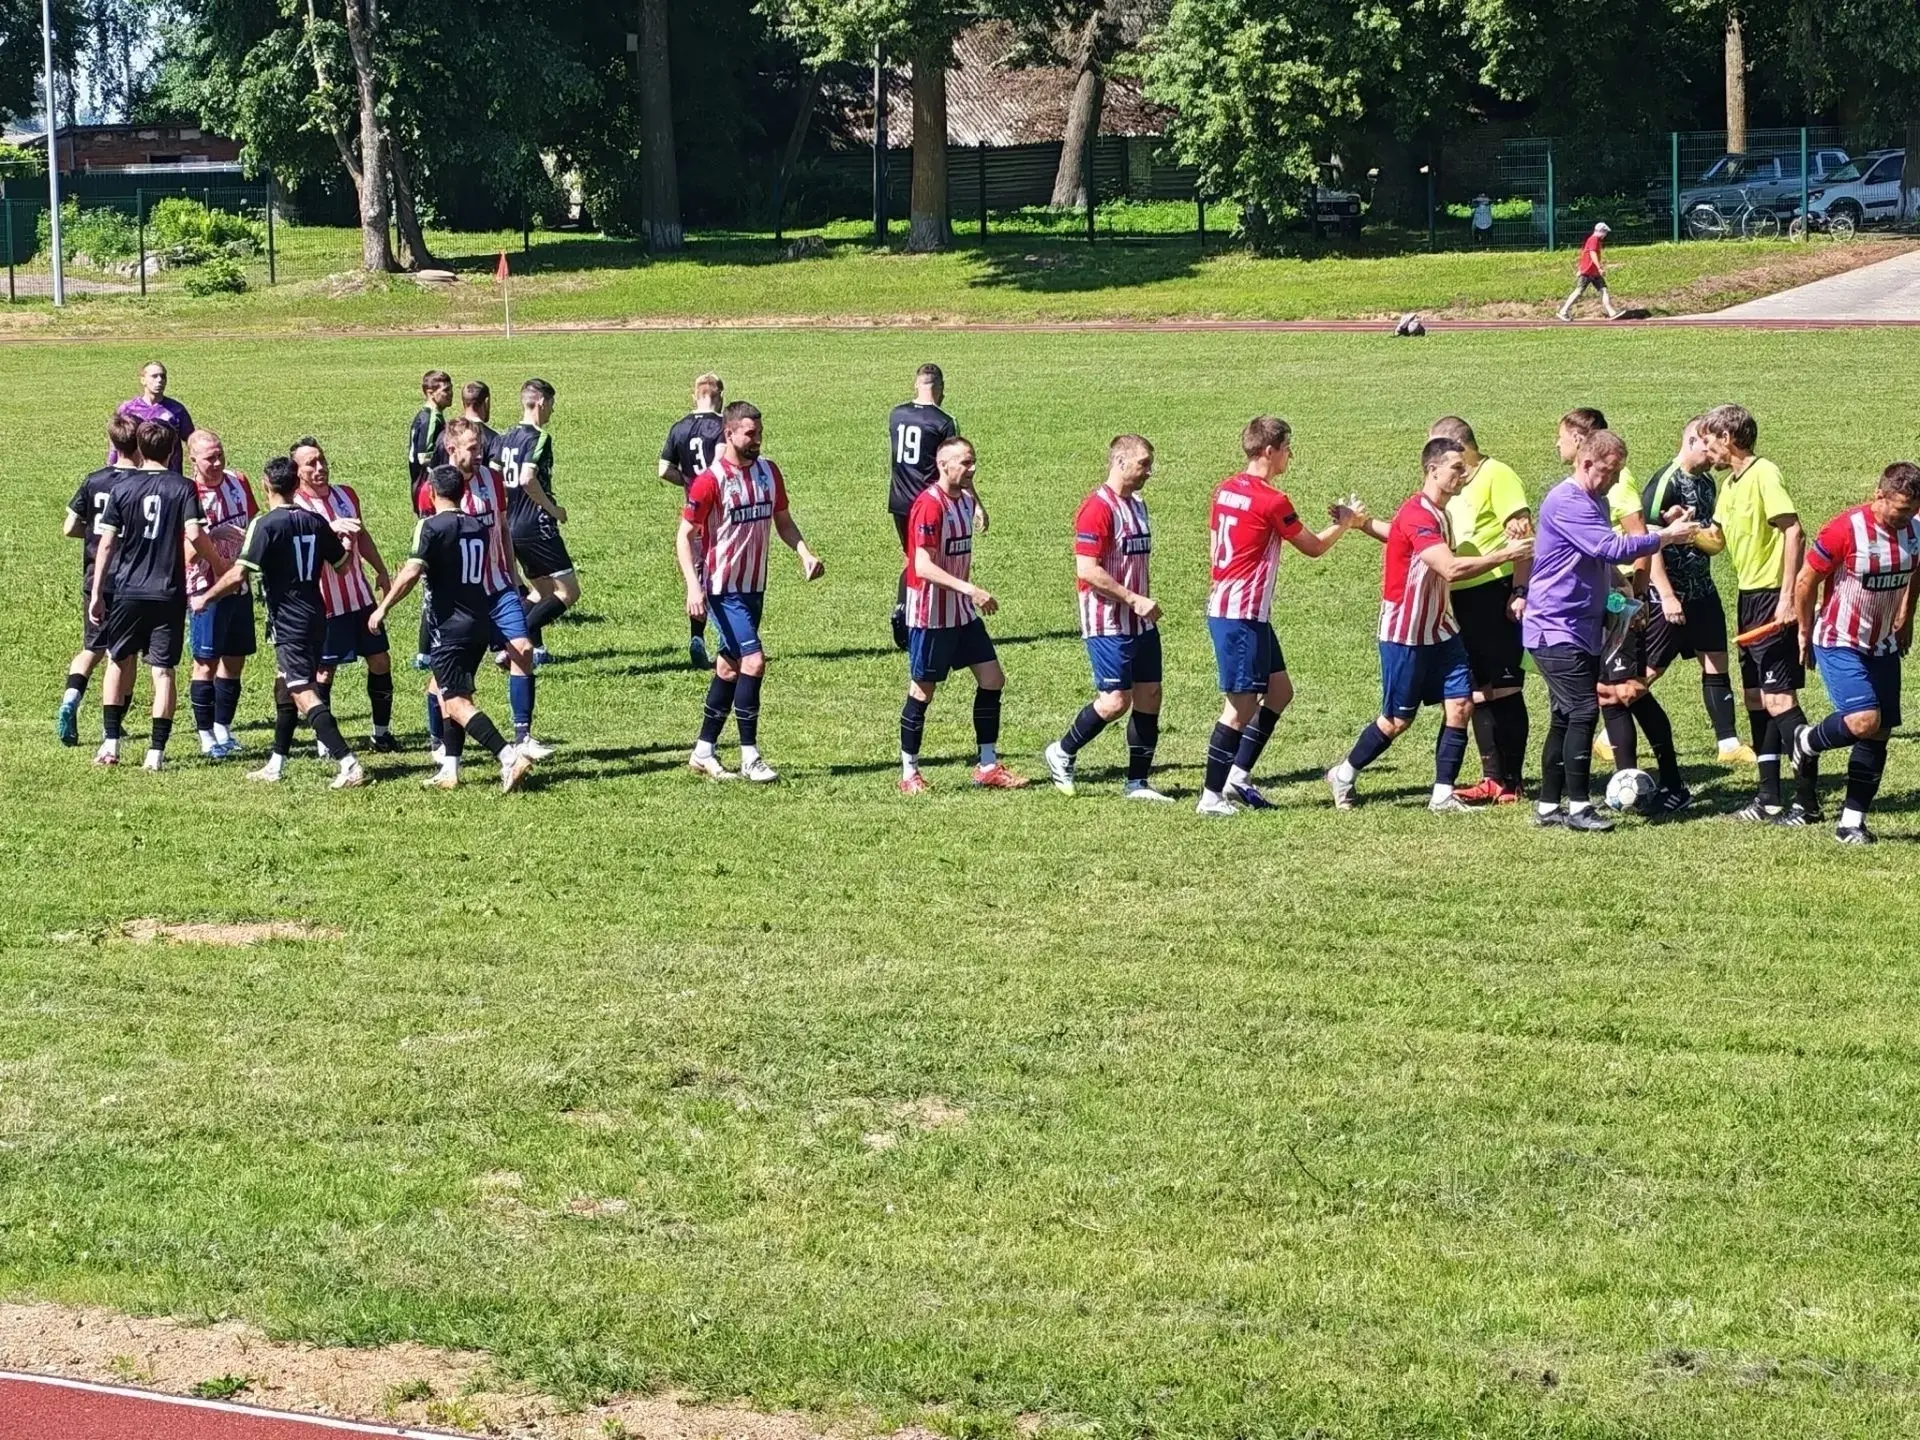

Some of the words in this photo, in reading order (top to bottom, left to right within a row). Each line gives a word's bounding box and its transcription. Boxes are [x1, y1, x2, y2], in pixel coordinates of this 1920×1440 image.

[690, 437, 707, 475] 3
[897, 424, 922, 465] 19
[143, 494, 162, 540] 9
[293, 533, 316, 582] 17
[459, 538, 484, 584] 10
[1214, 513, 1239, 569] 15
